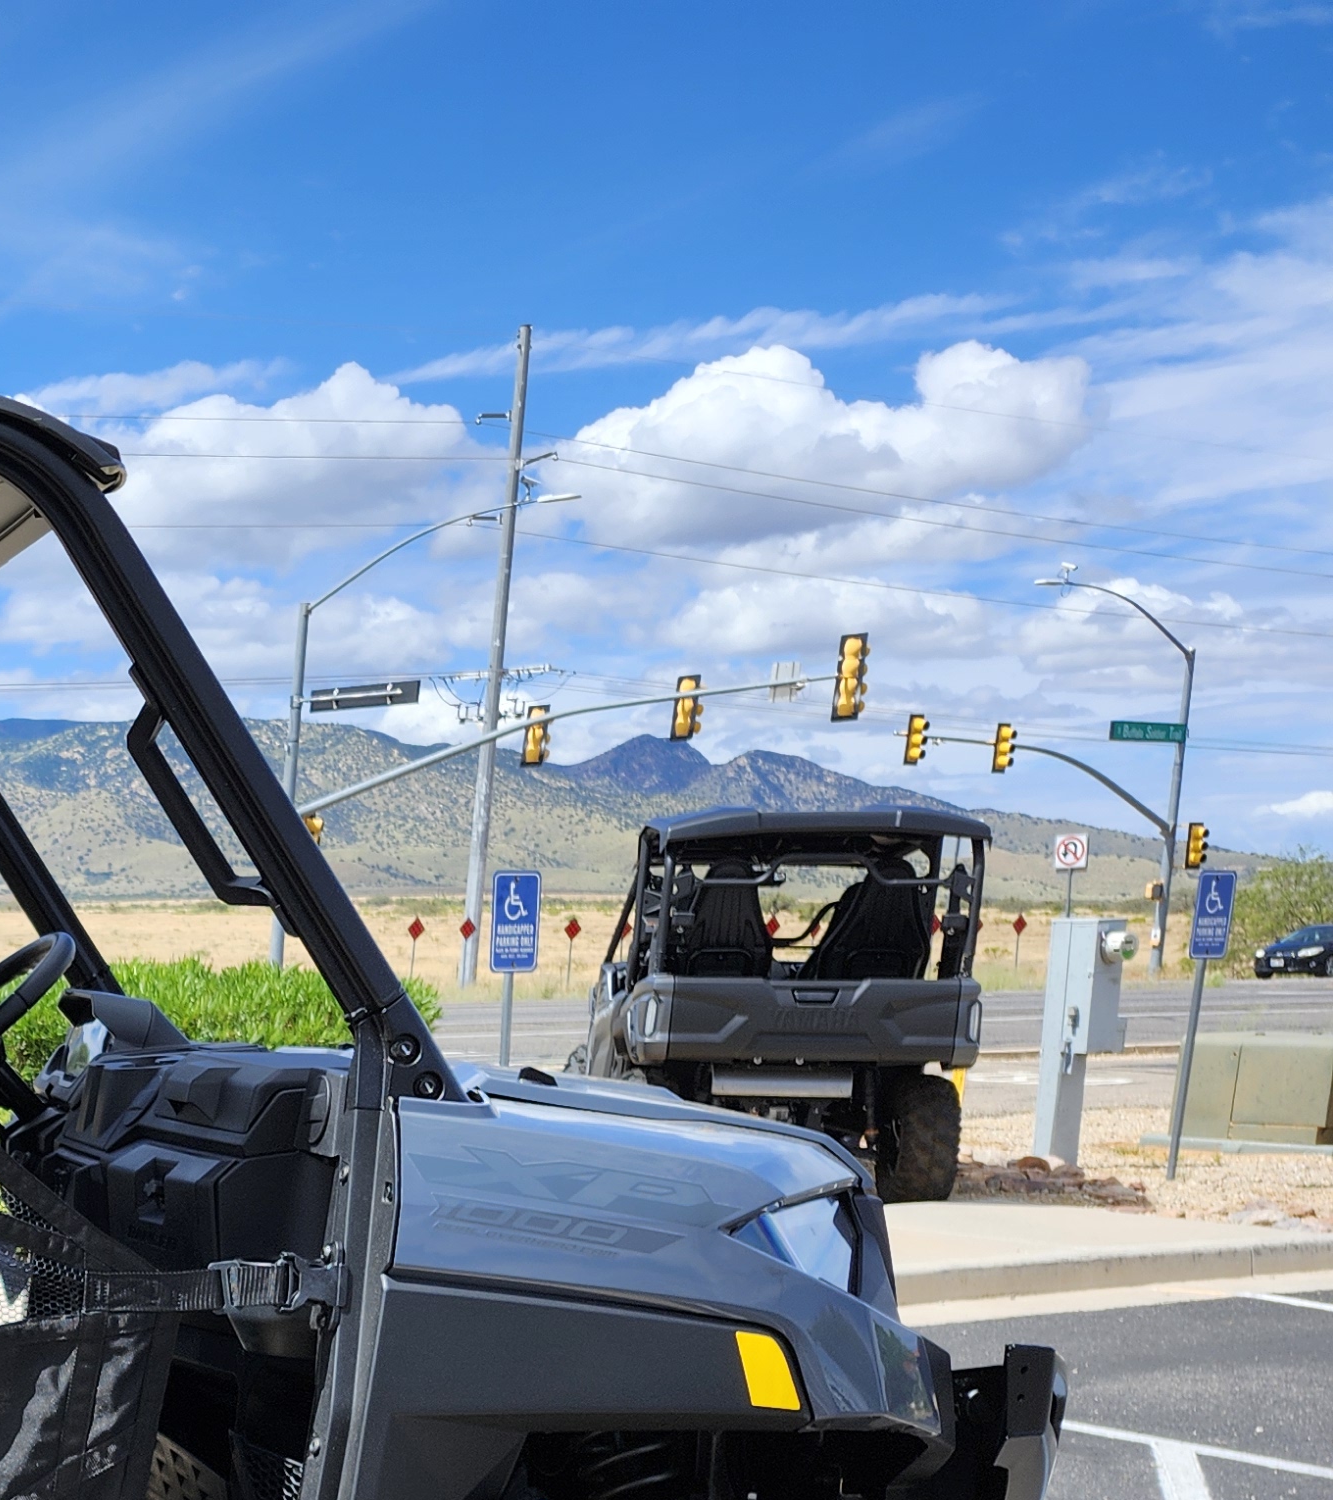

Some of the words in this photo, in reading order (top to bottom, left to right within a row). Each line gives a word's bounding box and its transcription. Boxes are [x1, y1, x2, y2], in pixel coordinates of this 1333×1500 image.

[495, 935, 520, 947] PARKING
[520, 935, 534, 947] ONLY
[496, 923, 535, 935] HANDICAPPED
[407, 1144, 725, 1222] XP
[435, 1201, 629, 1246] 1000
